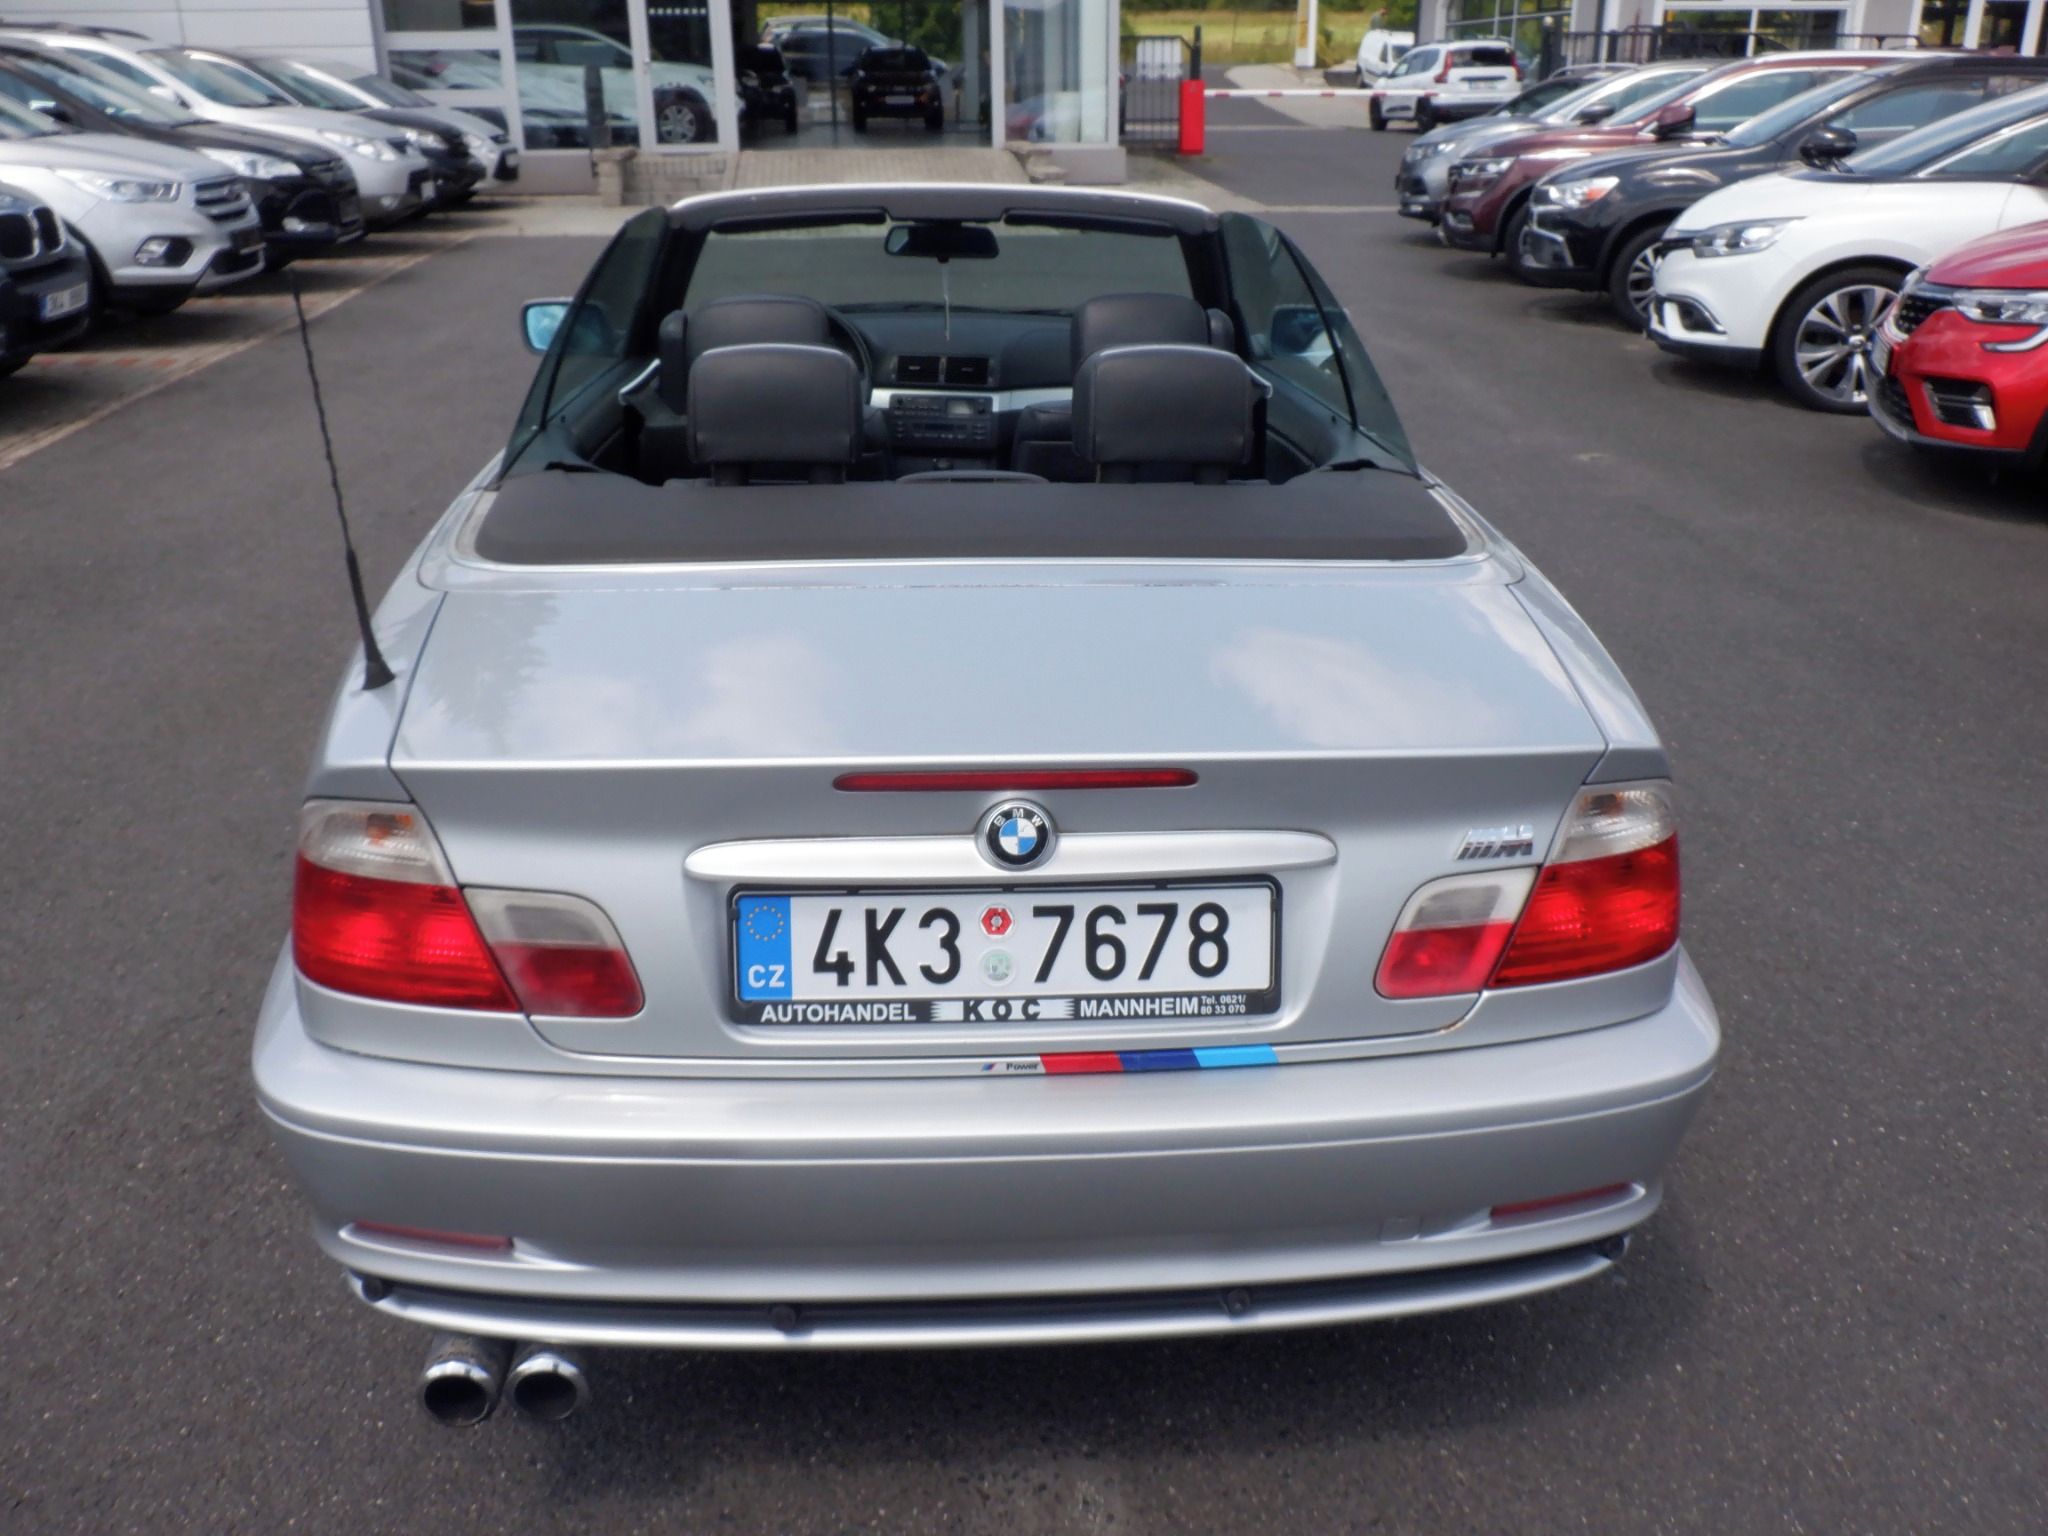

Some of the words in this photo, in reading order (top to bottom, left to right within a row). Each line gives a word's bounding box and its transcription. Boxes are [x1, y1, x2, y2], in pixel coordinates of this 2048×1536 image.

[994, 808, 1044, 828] BMW
[813, 907, 961, 986] 4K3
[1033, 902, 1229, 983] 7678
[748, 964, 785, 988] CZ
[761, 1003, 916, 1023] AUTOHANDEL
[1080, 996, 1199, 1018] MANNHEIM
[1201, 995, 1218, 1005] Tel.
[1215, 1005, 1226, 1015] 33
[1228, 1004, 1246, 1014] 070
[1006, 1062, 1038, 1071] Power
